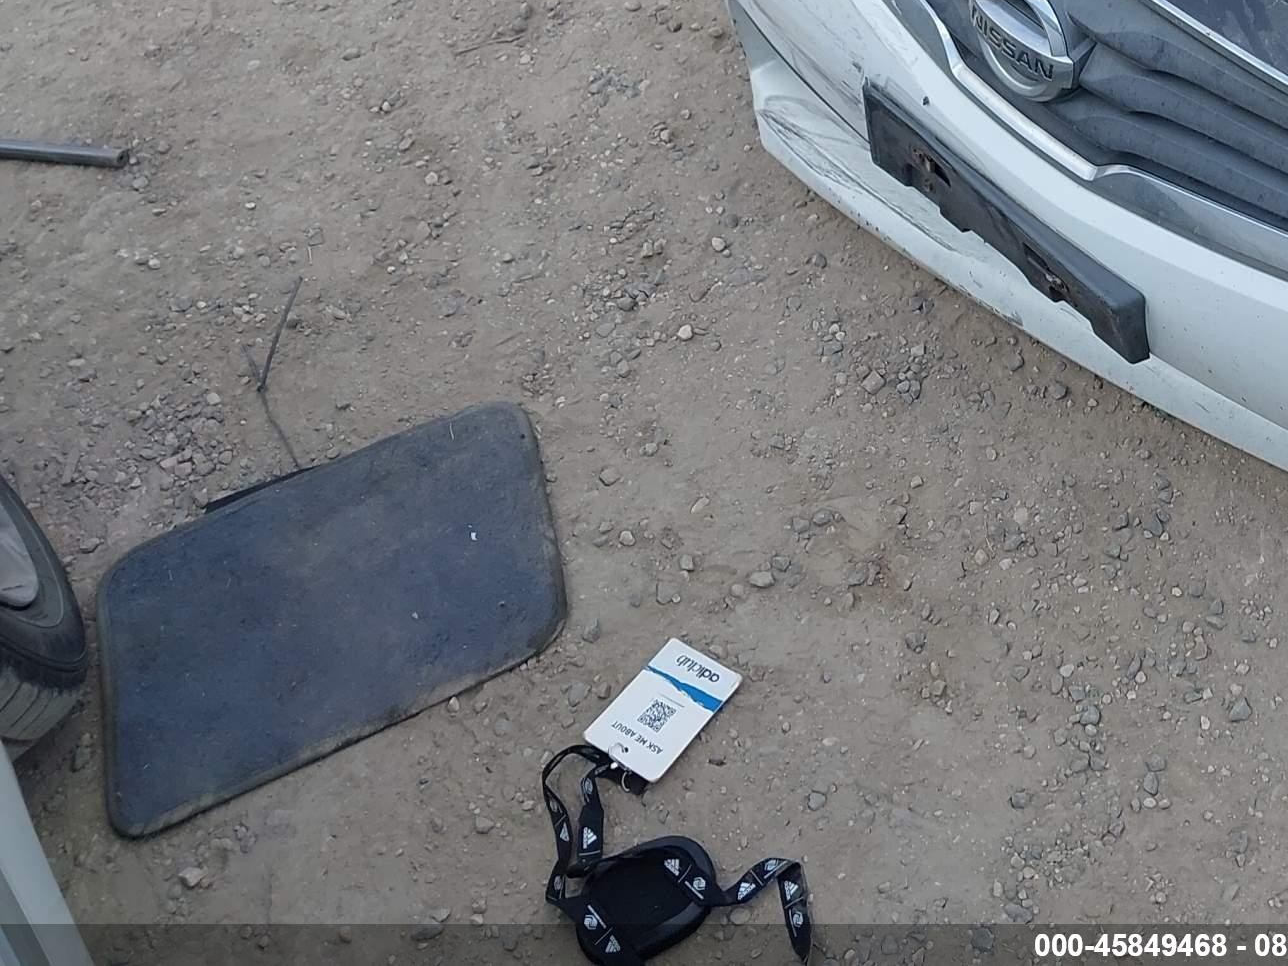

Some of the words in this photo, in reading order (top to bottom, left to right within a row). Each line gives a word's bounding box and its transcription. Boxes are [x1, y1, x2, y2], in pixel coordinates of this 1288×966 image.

[971, 2, 1053, 81] NISSAN
[676, 655, 720, 683] adiclub
[611, 720, 637, 737] ABOUT
[635, 734, 648, 745] ME
[647, 741, 664, 755] ASK
